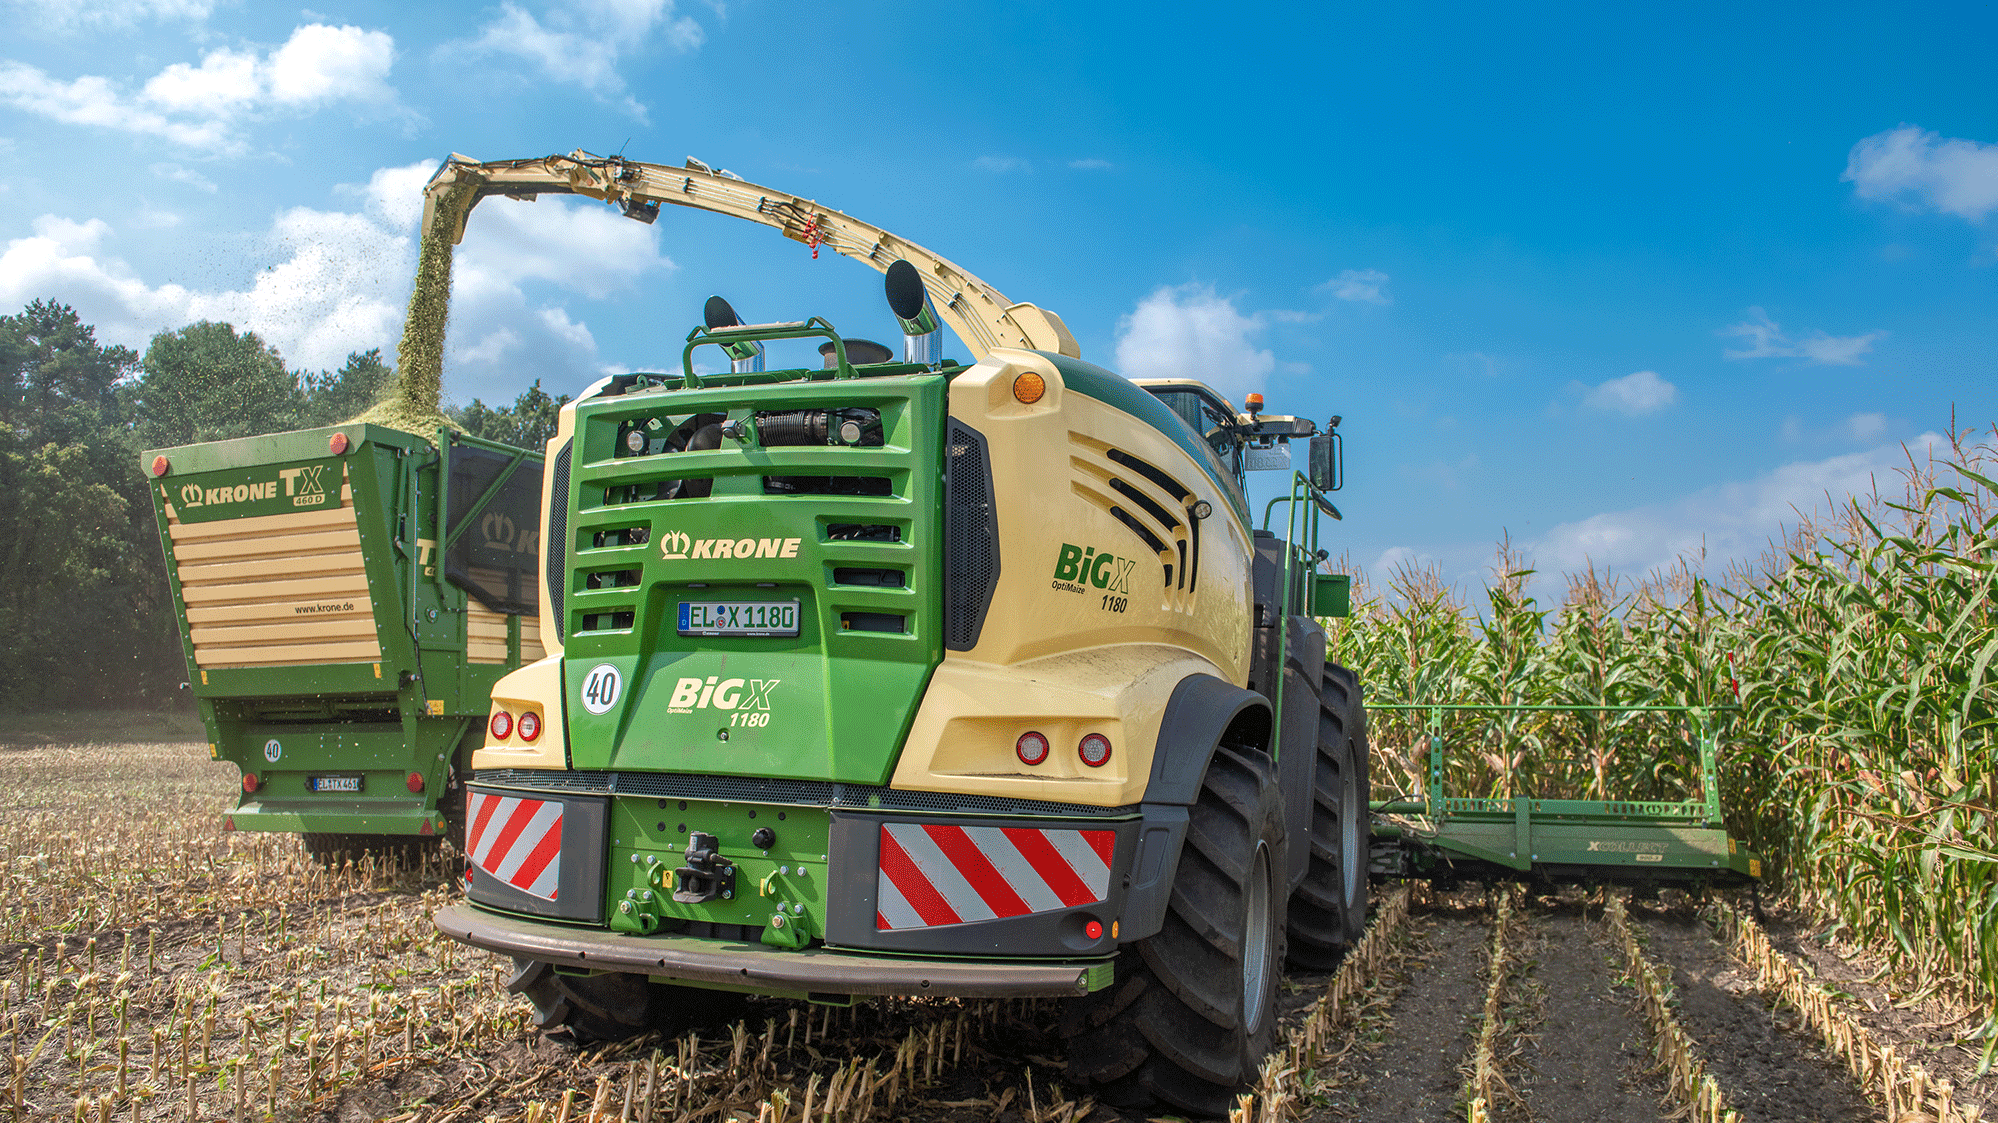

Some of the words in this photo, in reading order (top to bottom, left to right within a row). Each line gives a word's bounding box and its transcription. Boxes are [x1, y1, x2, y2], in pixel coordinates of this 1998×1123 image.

[205, 481, 278, 506] KRONE
[279, 465, 324, 497] TX
[295, 497, 313, 505] 460
[315, 495, 323, 503] D
[416, 538, 438, 566] T
[690, 538, 802, 560] KRONE
[1051, 580, 1086, 595] OptiMaize
[294, 601, 355, 614] www.krone.de
[1101, 594, 1128, 613] 1180
[690, 606, 715, 628] EL
[586, 672, 616, 706] 40
[730, 712, 771, 728] 1180
[266, 743, 279, 759] 40
